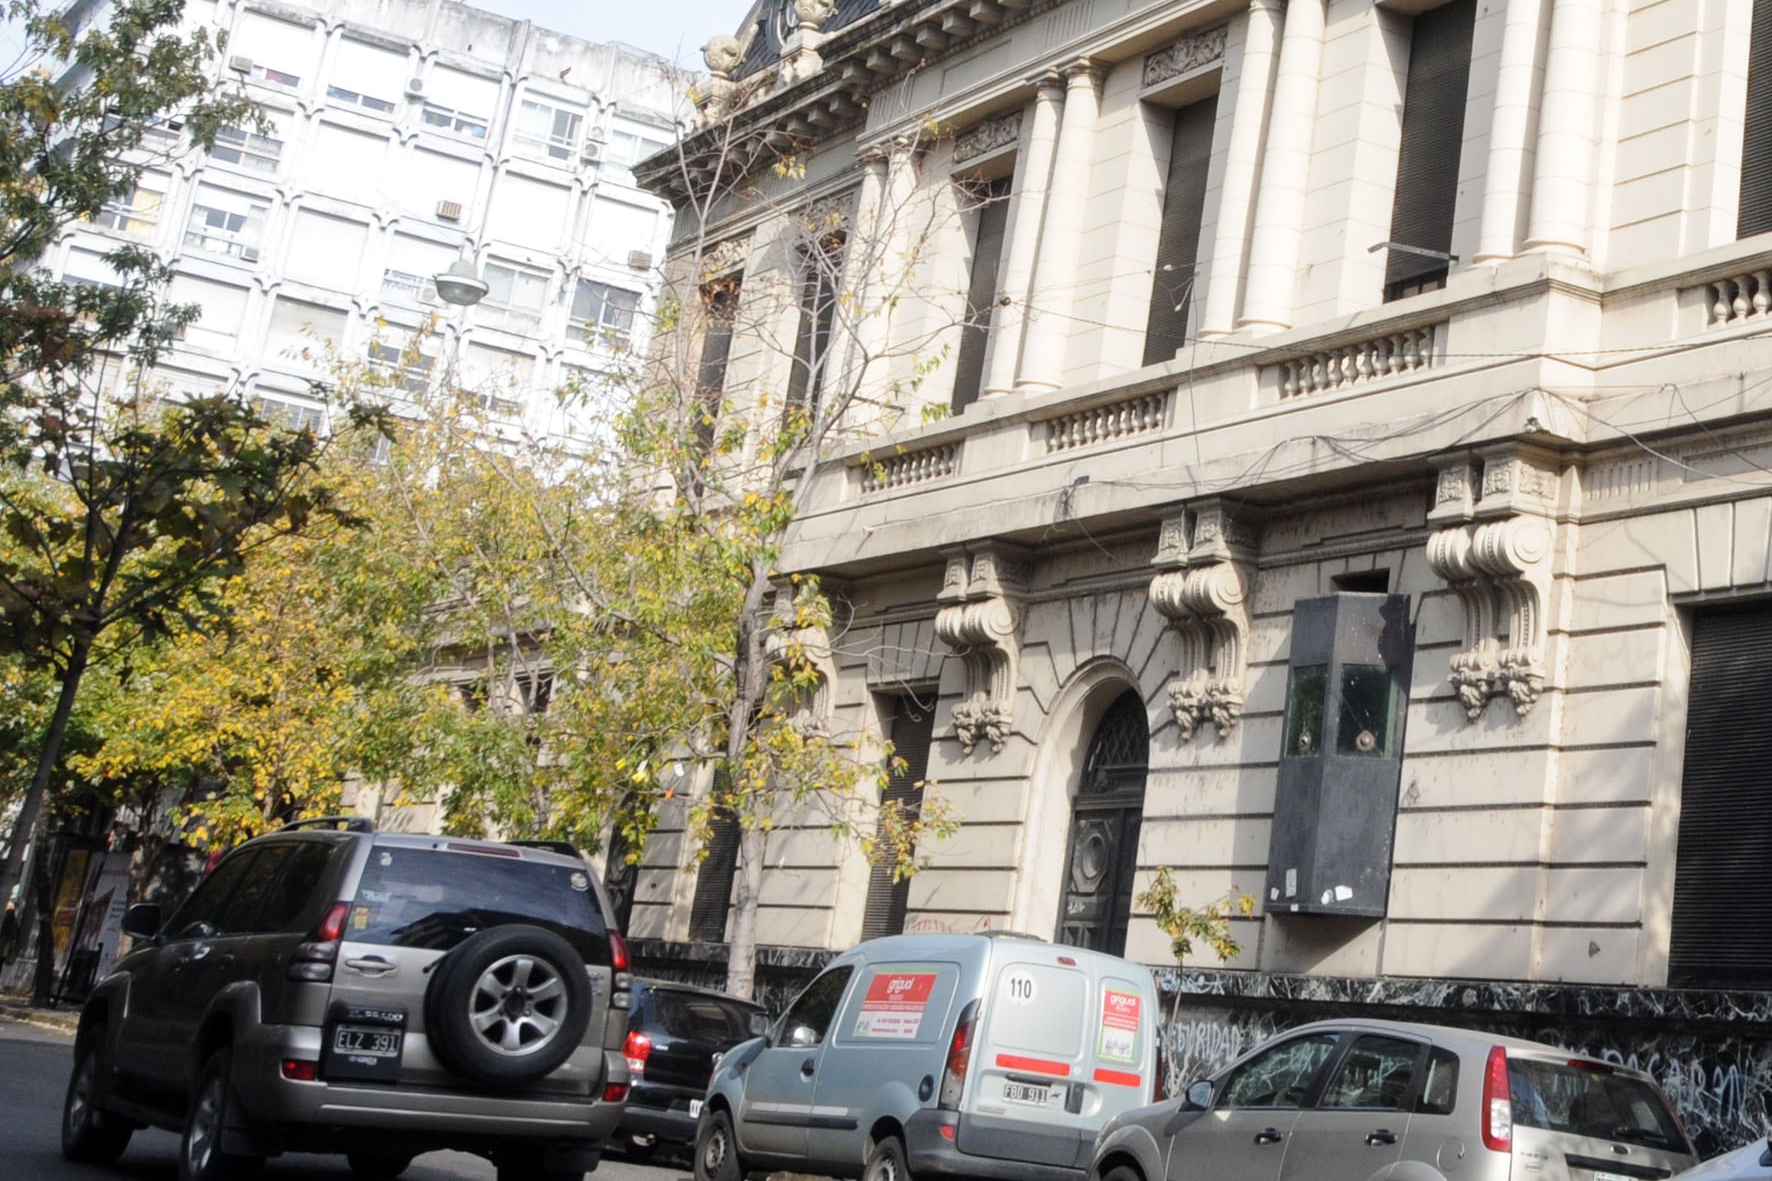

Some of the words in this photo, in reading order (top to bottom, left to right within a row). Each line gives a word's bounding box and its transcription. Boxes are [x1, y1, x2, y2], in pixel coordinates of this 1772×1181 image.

[1010, 978, 1032, 999] 110
[337, 1031, 365, 1049] ELZ
[371, 1034, 396, 1052] 391
[1027, 1088, 1047, 1103] 911
